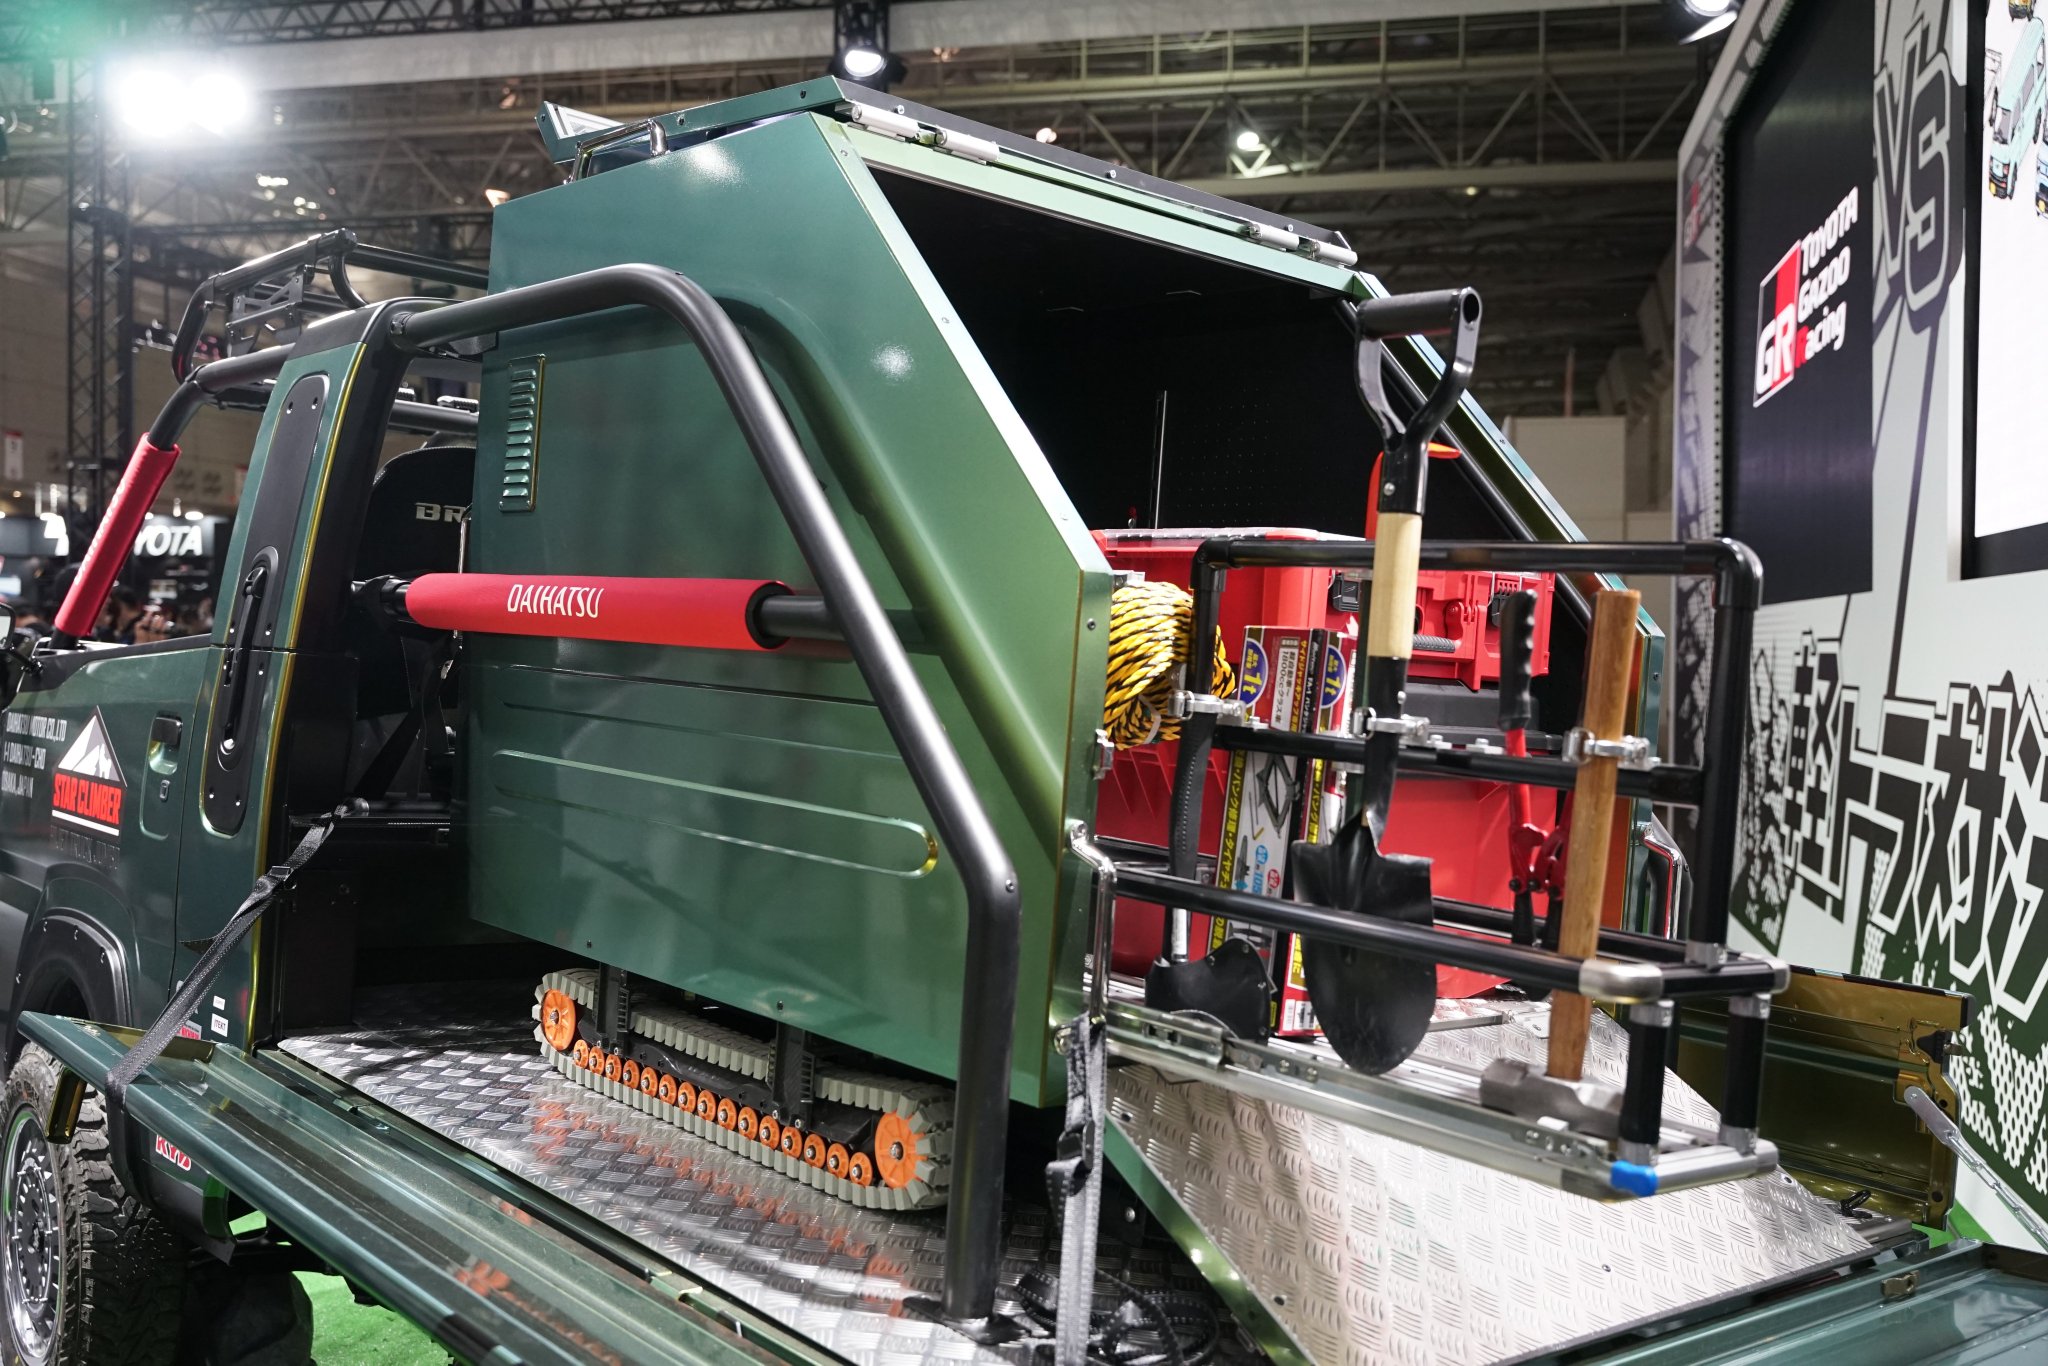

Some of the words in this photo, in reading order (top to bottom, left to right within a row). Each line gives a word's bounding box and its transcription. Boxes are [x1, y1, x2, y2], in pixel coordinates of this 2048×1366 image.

[1800, 186, 1859, 277] TOYOTA
[1797, 245, 1851, 324] GAZOO
[1755, 302, 1795, 395] GR
[1794, 301, 1847, 369] Racing
[415, 502, 467, 523] BR
[133, 525, 203, 556] YOTA
[507, 583, 605, 619] DAIHATSU
[29, 715, 48, 739] MOTOR
[53, 773, 79, 812] STAR
[77, 779, 122, 825] CLIMBER
